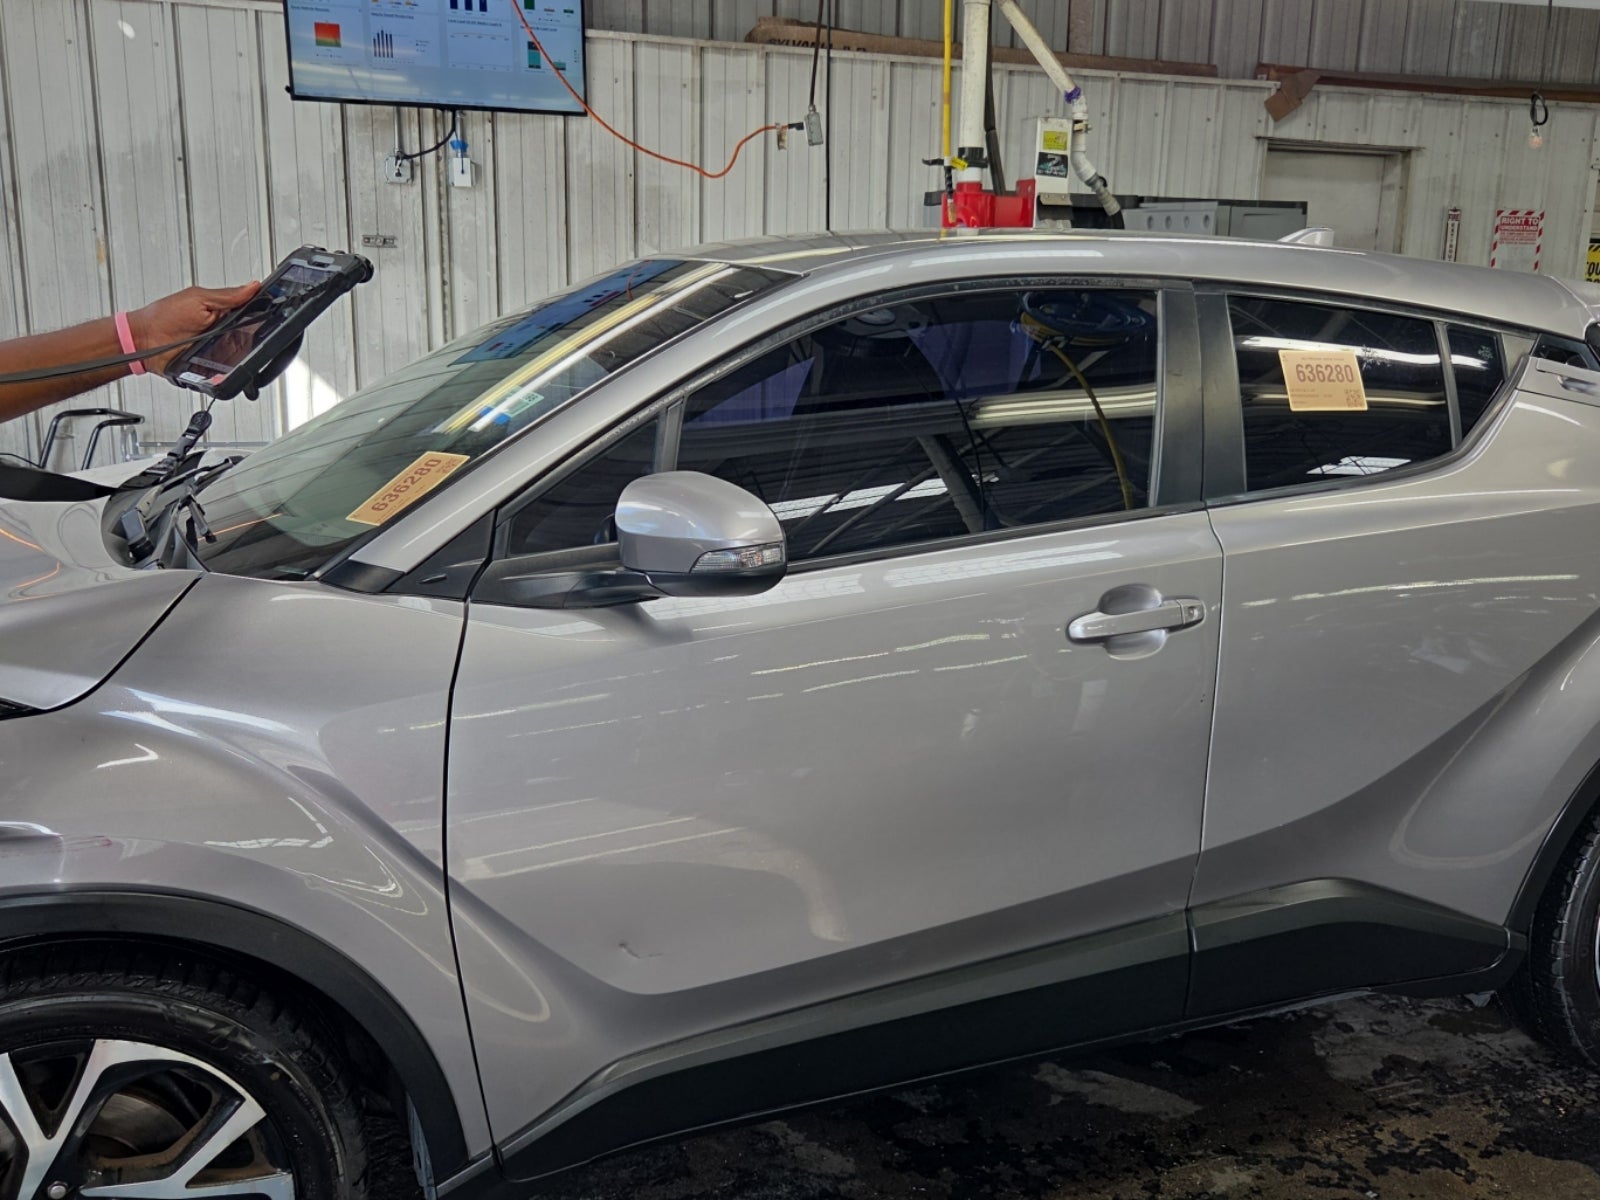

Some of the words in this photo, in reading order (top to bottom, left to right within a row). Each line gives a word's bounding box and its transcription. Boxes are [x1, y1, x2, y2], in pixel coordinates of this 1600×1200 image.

[1501, 217, 1525, 225] RIGHT
[1295, 364, 1354, 383] 636280
[371, 458, 442, 512] 636280
